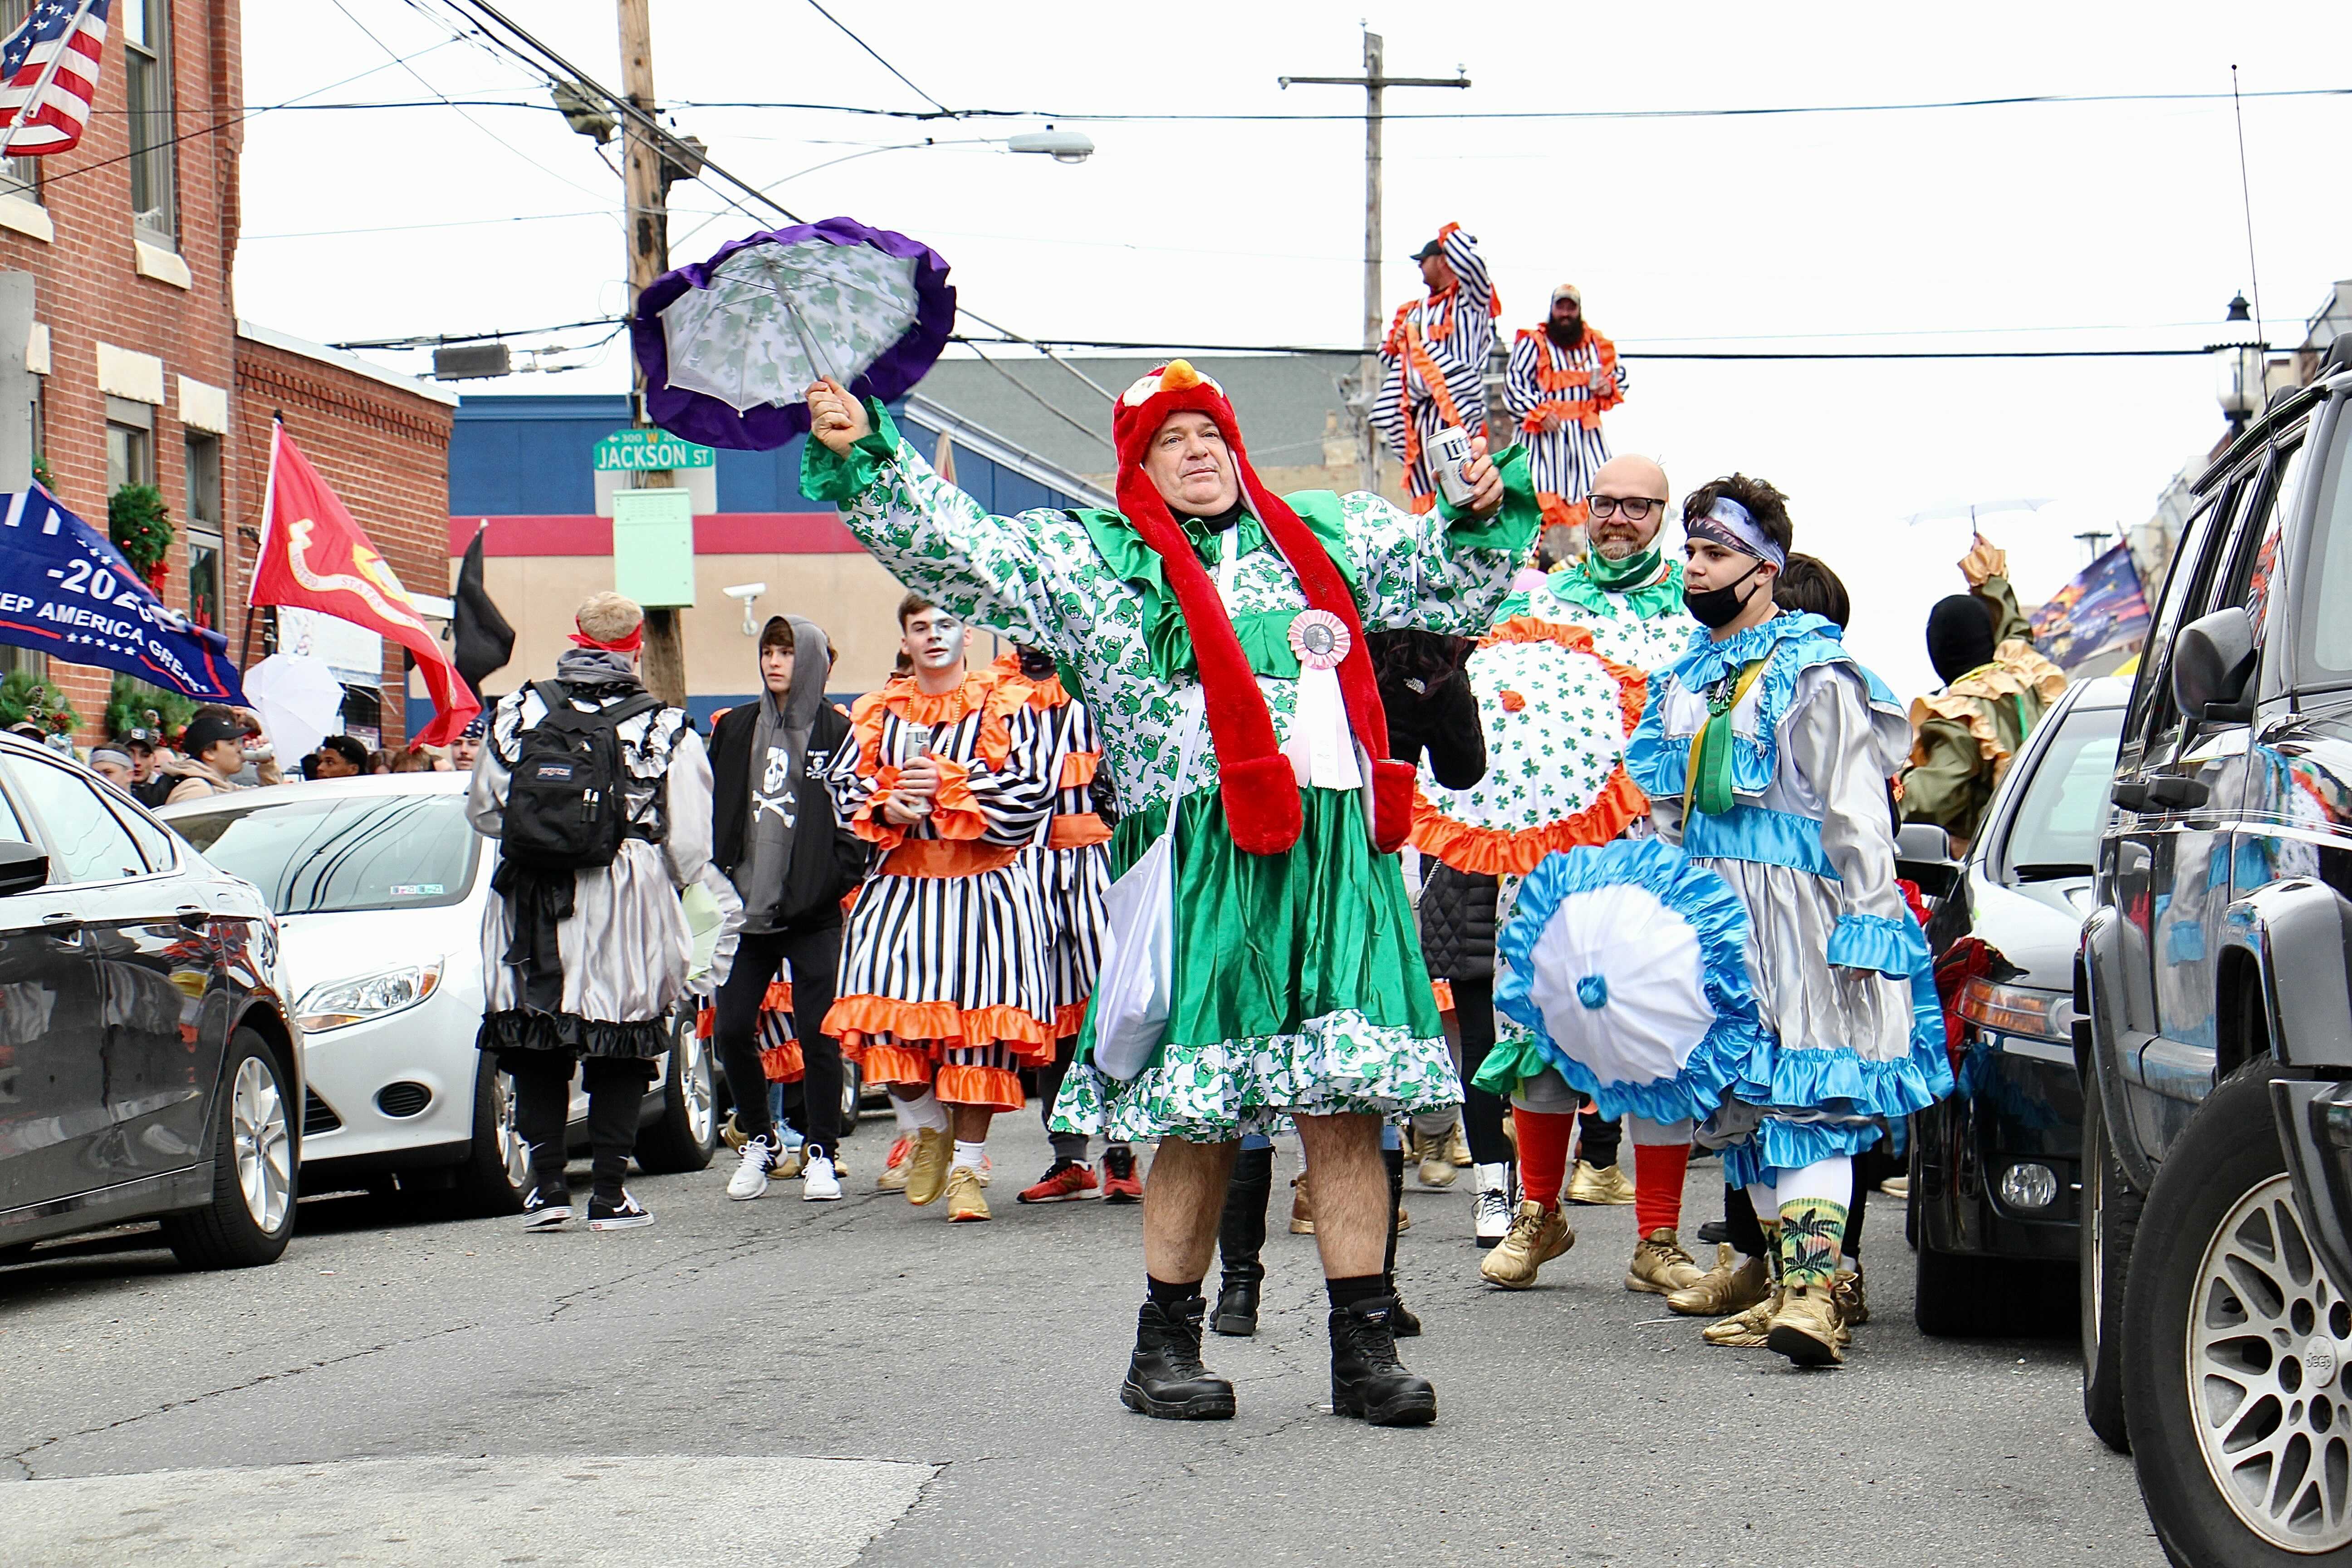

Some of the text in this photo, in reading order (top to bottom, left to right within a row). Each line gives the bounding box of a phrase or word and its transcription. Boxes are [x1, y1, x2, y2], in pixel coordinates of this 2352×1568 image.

[646, 432, 658, 443] W
[598, 443, 709, 469] JACKSON ST
[36, 602, 145, 647] AMERICA
[2305, 1352, 2331, 1370] Jeep
